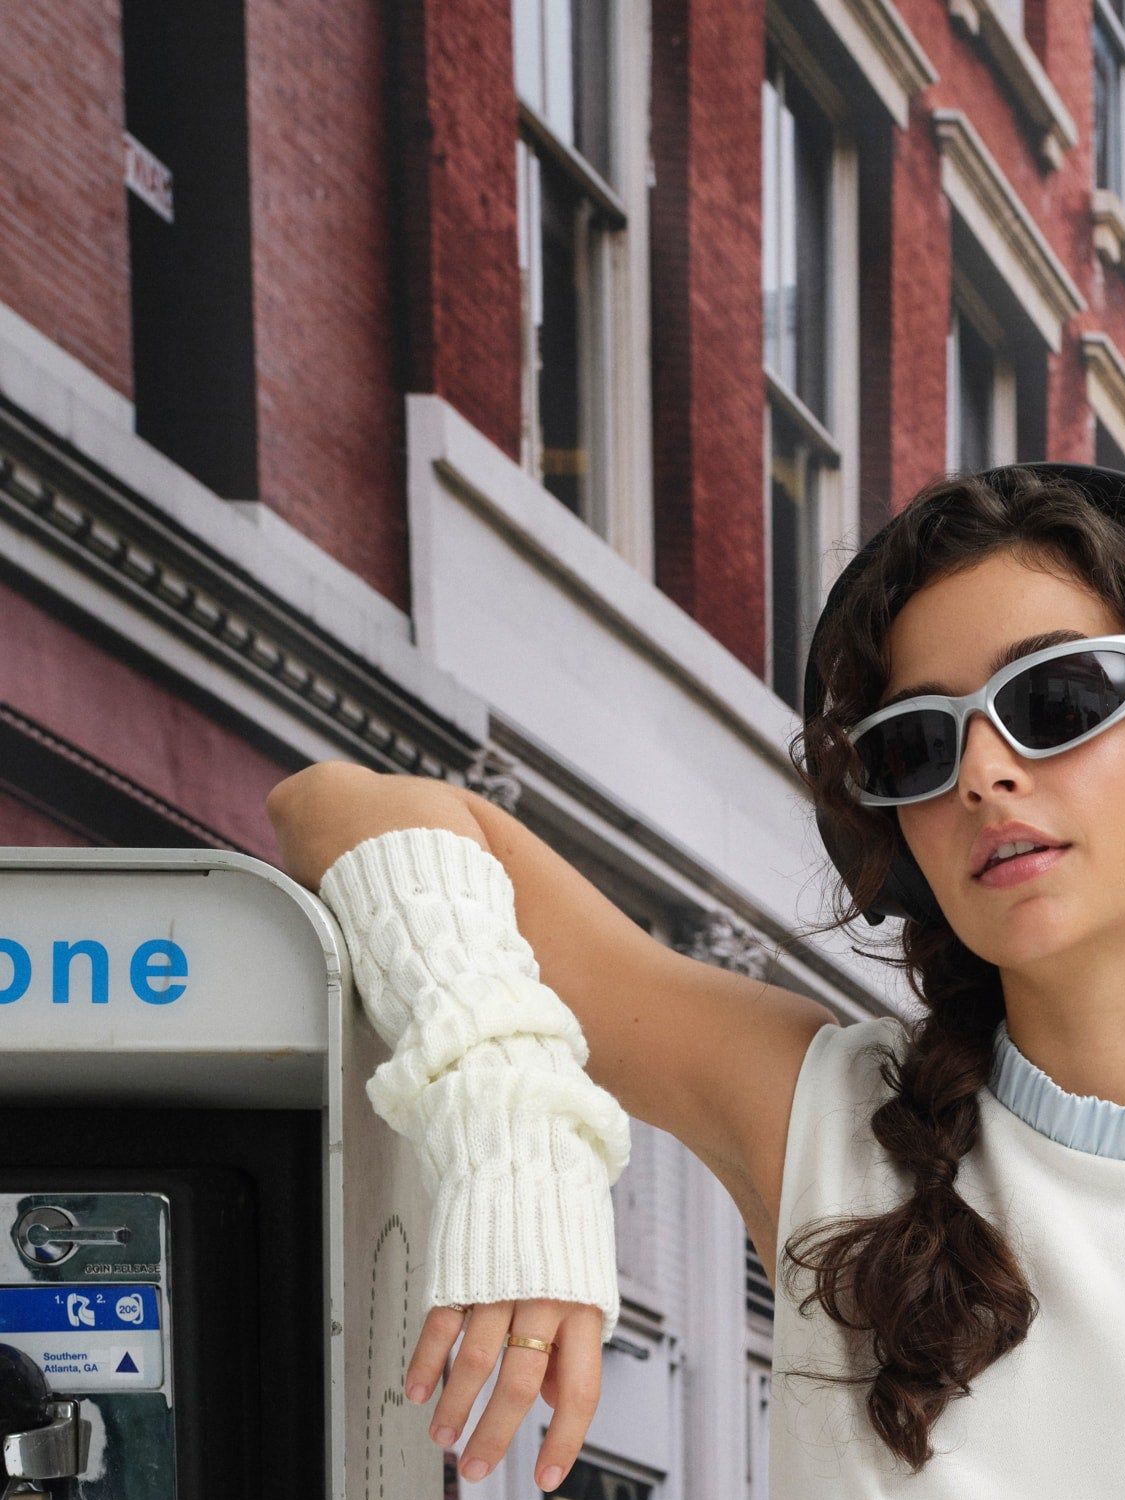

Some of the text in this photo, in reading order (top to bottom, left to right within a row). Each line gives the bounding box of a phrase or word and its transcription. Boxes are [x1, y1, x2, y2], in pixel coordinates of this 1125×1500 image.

[85, 1264, 160, 1274] COIN RELEASE
[43, 1352, 88, 1361] Southern
[44, 1364, 98, 1374] Atlanta, GA
